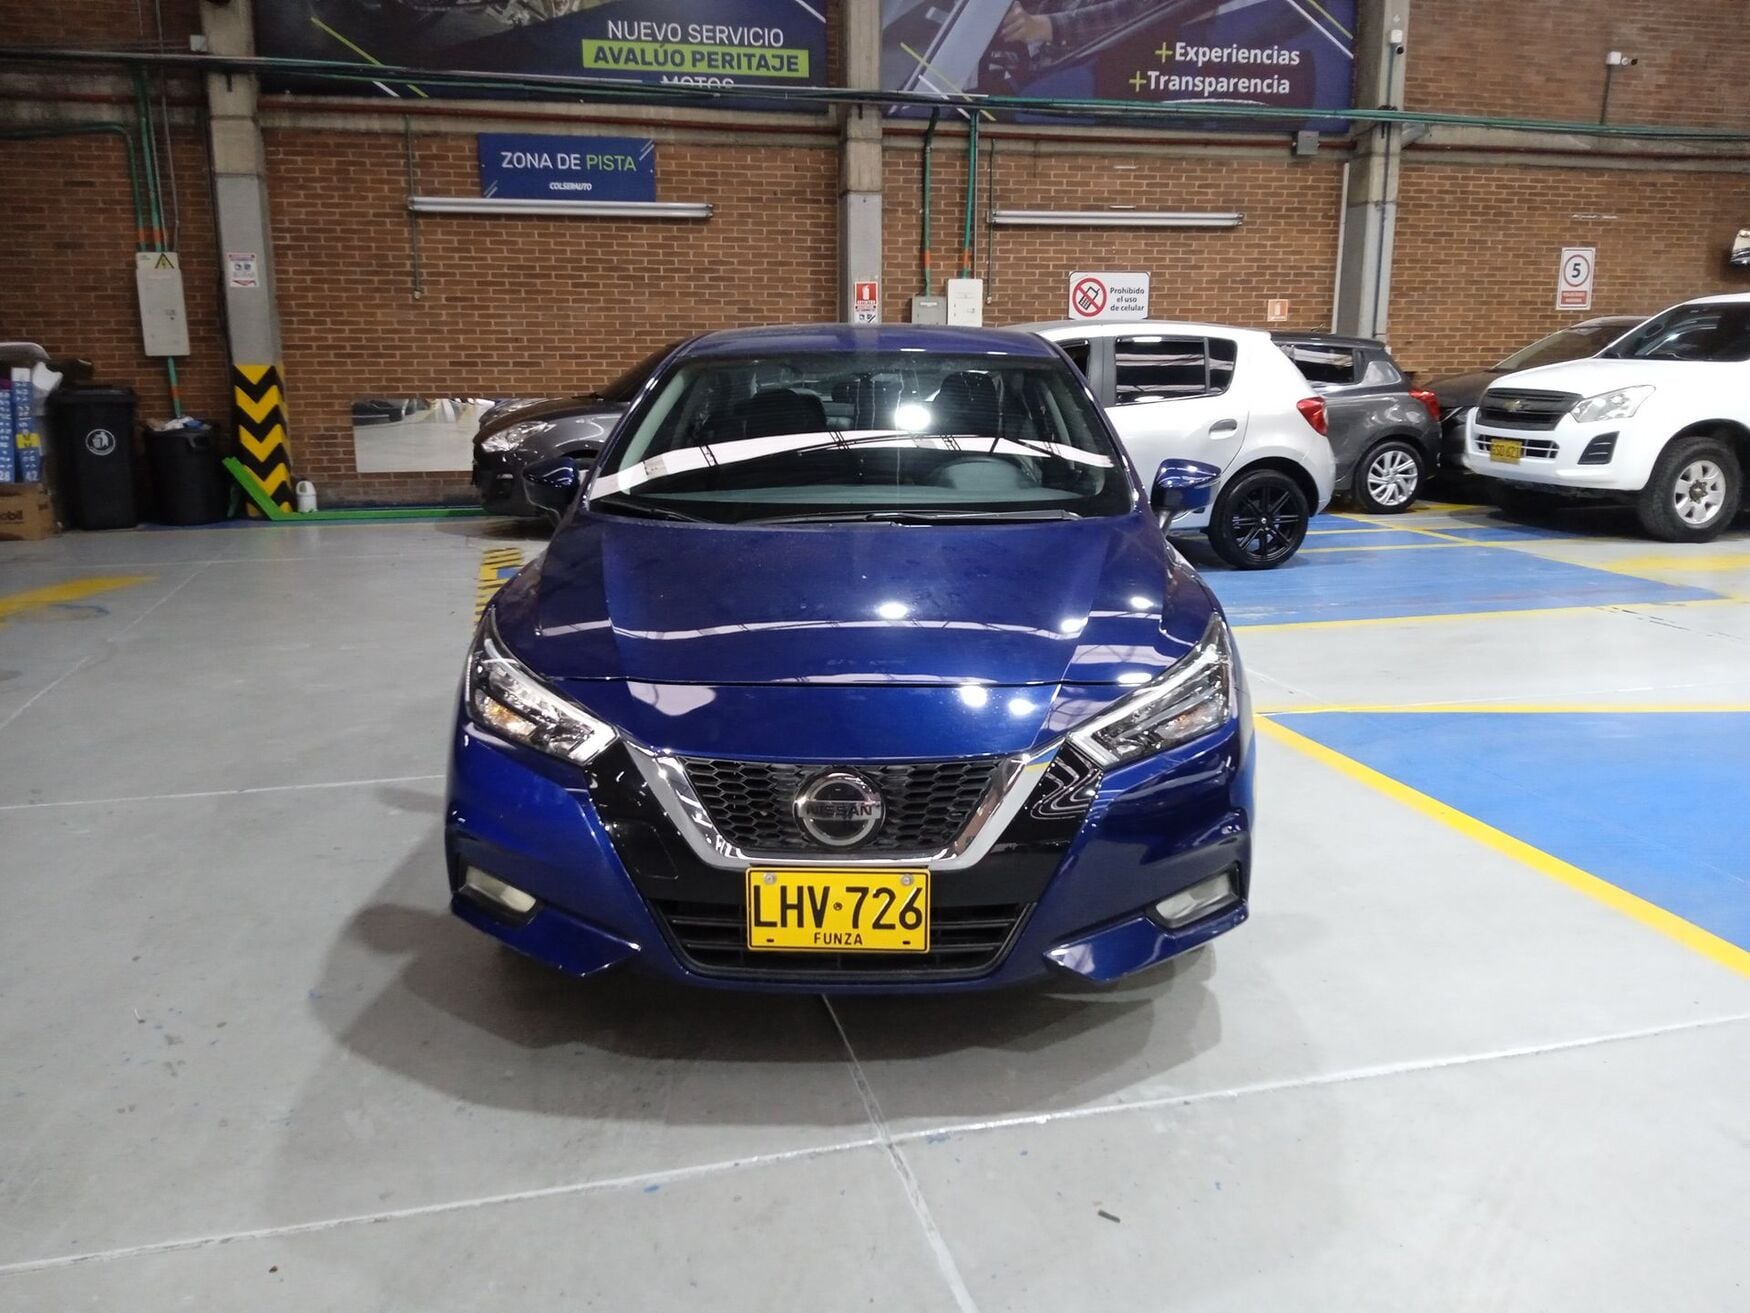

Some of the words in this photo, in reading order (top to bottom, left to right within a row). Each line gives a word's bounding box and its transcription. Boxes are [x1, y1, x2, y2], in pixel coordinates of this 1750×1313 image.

[607, 19, 682, 42] NUEVO
[687, 24, 785, 48] SERVICIO
[593, 43, 686, 68] AVALÚO
[691, 51, 800, 73] PERITAJE
[500, 151, 553, 169] ZONA
[556, 153, 582, 170] DE
[585, 154, 637, 172] PISTA
[1571, 262, 1581, 278] 5
[1109, 286, 1145, 295] Prohibido
[1120, 304, 1145, 312] celular
[806, 804, 873, 817] NISSAN
[813, 932, 864, 946] FUNZA
